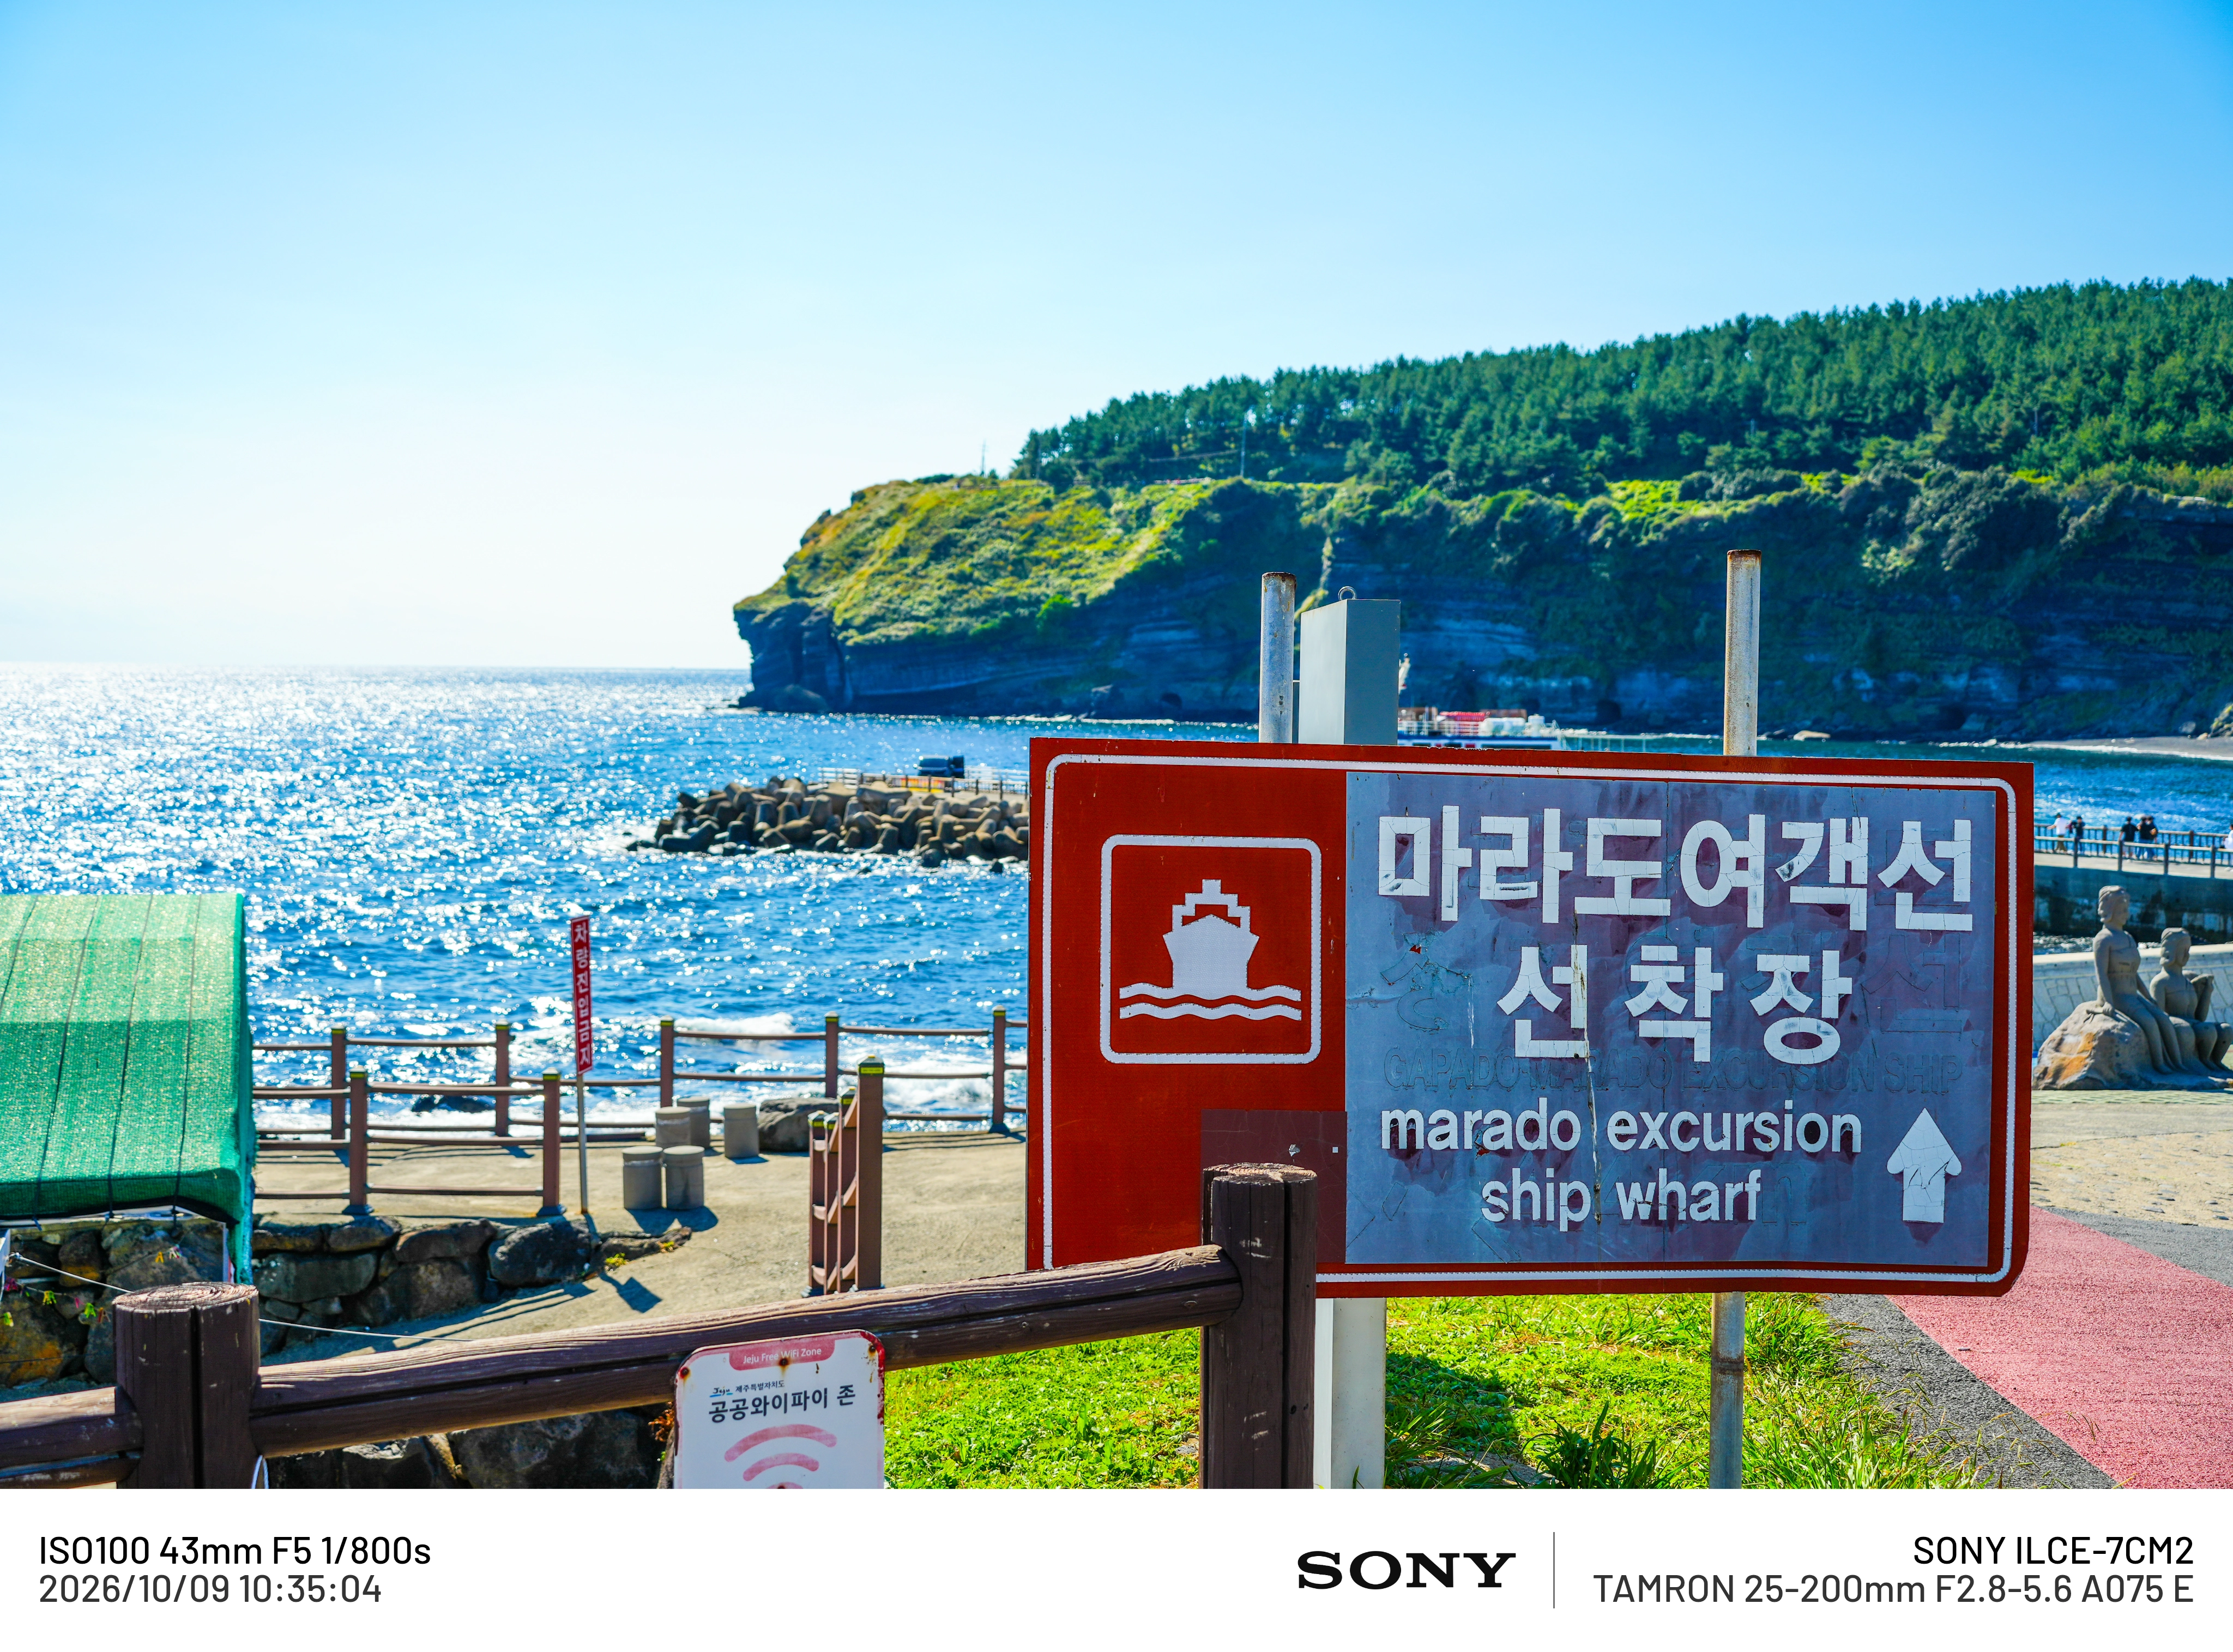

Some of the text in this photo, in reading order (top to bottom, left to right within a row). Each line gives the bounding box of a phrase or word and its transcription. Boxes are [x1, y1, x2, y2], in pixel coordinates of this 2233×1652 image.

[1378, 805, 1973, 931] 마라도여객선
[574, 921, 590, 1065] 차량진입금지
[1884, 1052, 1963, 1094] SHIP
[1381, 1097, 1861, 1153] marado excursion
[1481, 1168, 1591, 1232] ship
[1615, 1168, 1761, 1221] wharf
[743, 1348, 822, 1364] Jeju Free WiFi Zone
[709, 1384, 856, 1424] 공공와이파이 존
[713, 1386, 731, 1396] Jeju
[735, 1380, 785, 1393] 제주특별자치도
